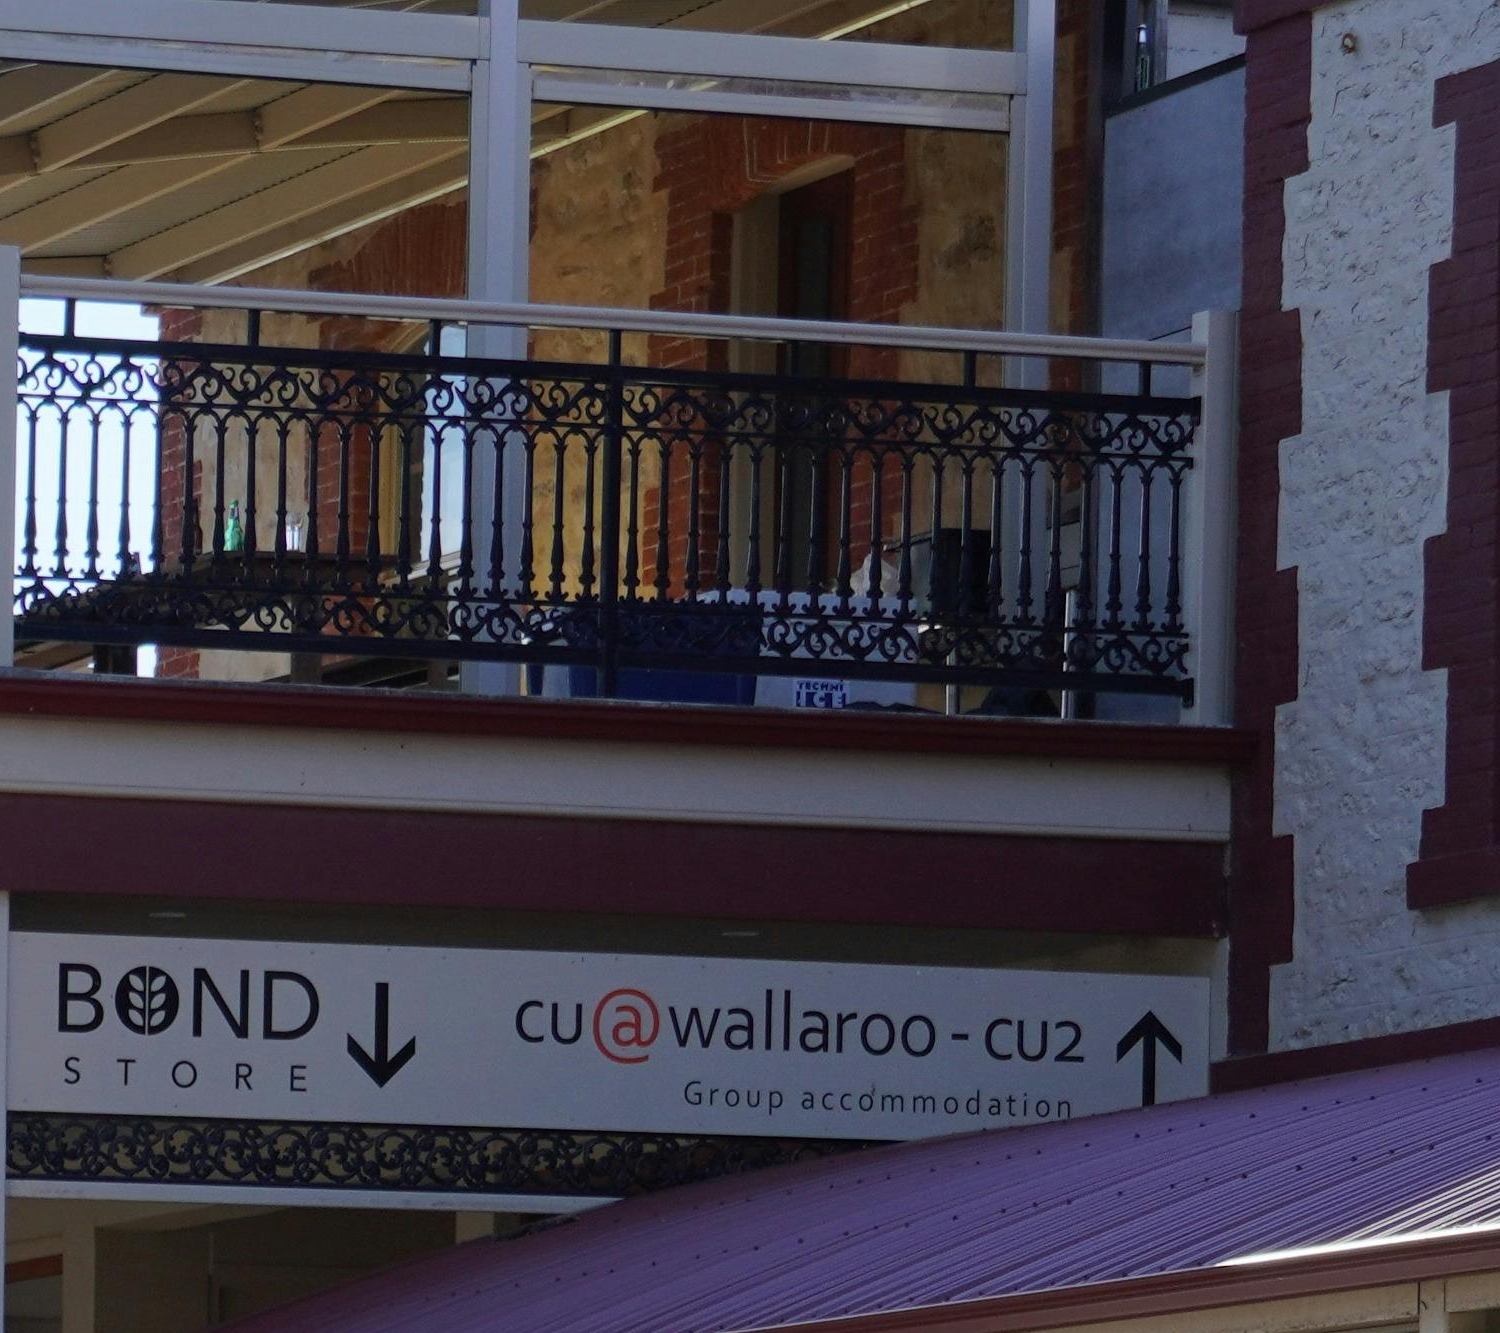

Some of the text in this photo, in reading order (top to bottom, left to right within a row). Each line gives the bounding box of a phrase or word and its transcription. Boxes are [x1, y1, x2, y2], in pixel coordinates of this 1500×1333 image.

[57, 963, 320, 1041] BOND
[64, 1056, 308, 1093] STORE
[683, 1081, 1074, 1119] Group accommodation
